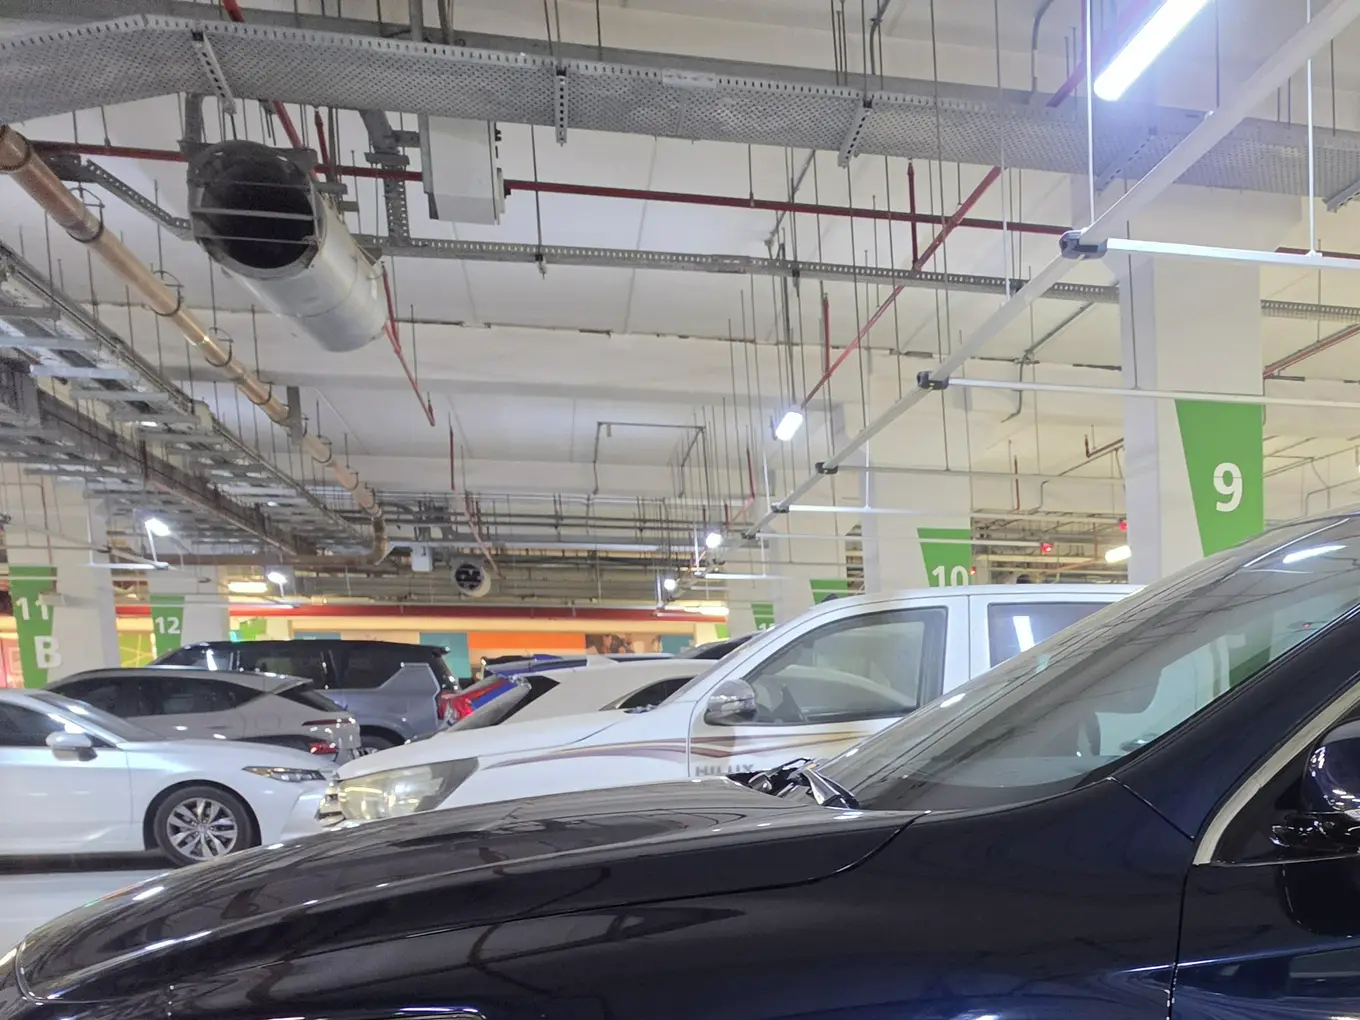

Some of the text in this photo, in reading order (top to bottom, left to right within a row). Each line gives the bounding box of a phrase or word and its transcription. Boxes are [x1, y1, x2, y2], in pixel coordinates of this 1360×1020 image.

[1213, 462, 1243, 512] 9
[932, 565, 970, 588] 10
[16, 597, 50, 621] 11
[155, 616, 181, 634] 12
[34, 635, 62, 669] B
